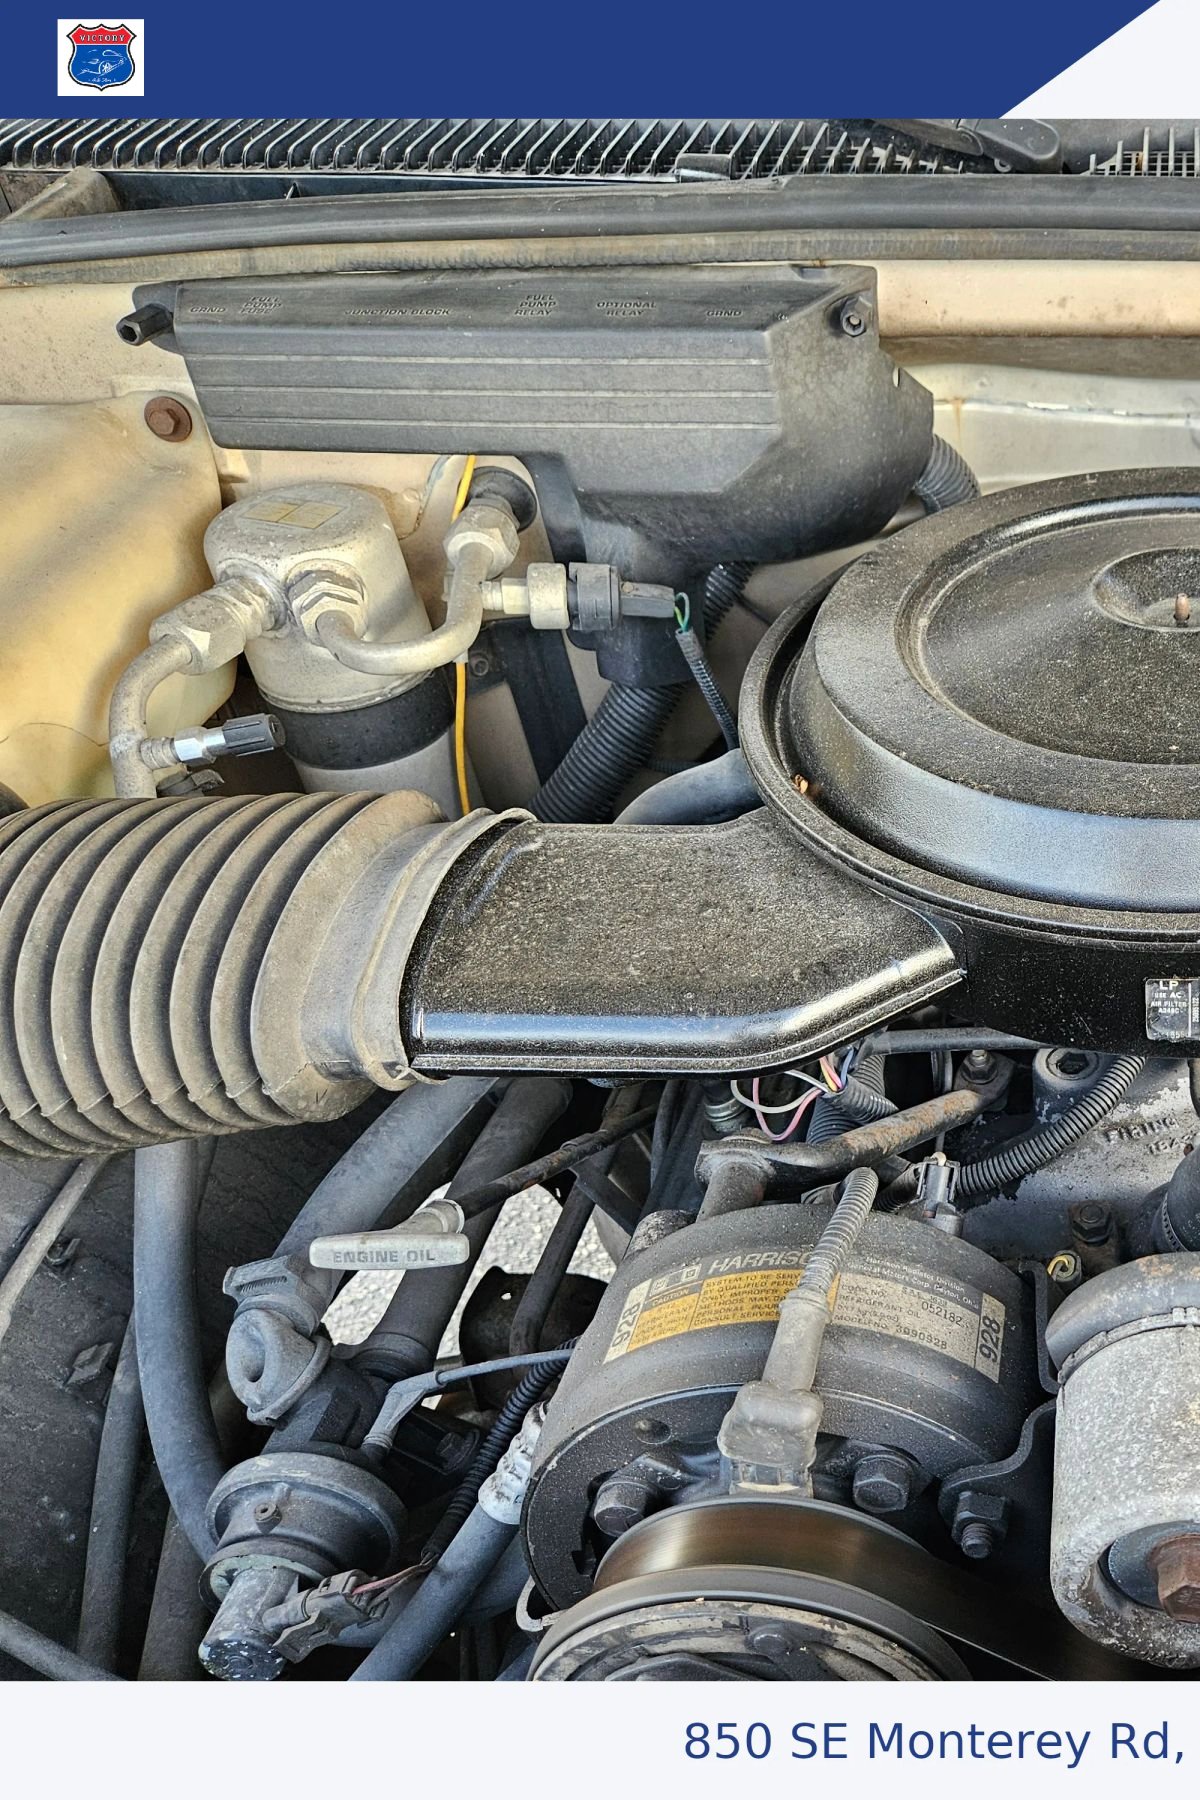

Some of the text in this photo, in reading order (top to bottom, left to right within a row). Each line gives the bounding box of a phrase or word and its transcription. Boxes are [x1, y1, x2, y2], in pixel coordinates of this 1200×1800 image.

[1159, 980, 1178, 990] LP
[333, 1250, 436, 1263] ENGINE OIL
[707, 1251, 811, 1275] HARRISO
[706, 1277, 743, 1288] SYSTEM
[717, 1281, 767, 1293] QUALIFIED
[911, 1275, 932, 1289] Corp.
[730, 1288, 778, 1299] IMPROPER
[695, 1305, 743, 1318] PERSONAL
[699, 1299, 744, 1311] METHODS
[693, 1310, 781, 1326] CONSULT SERVIC
[979, 1315, 1001, 1363] 928
